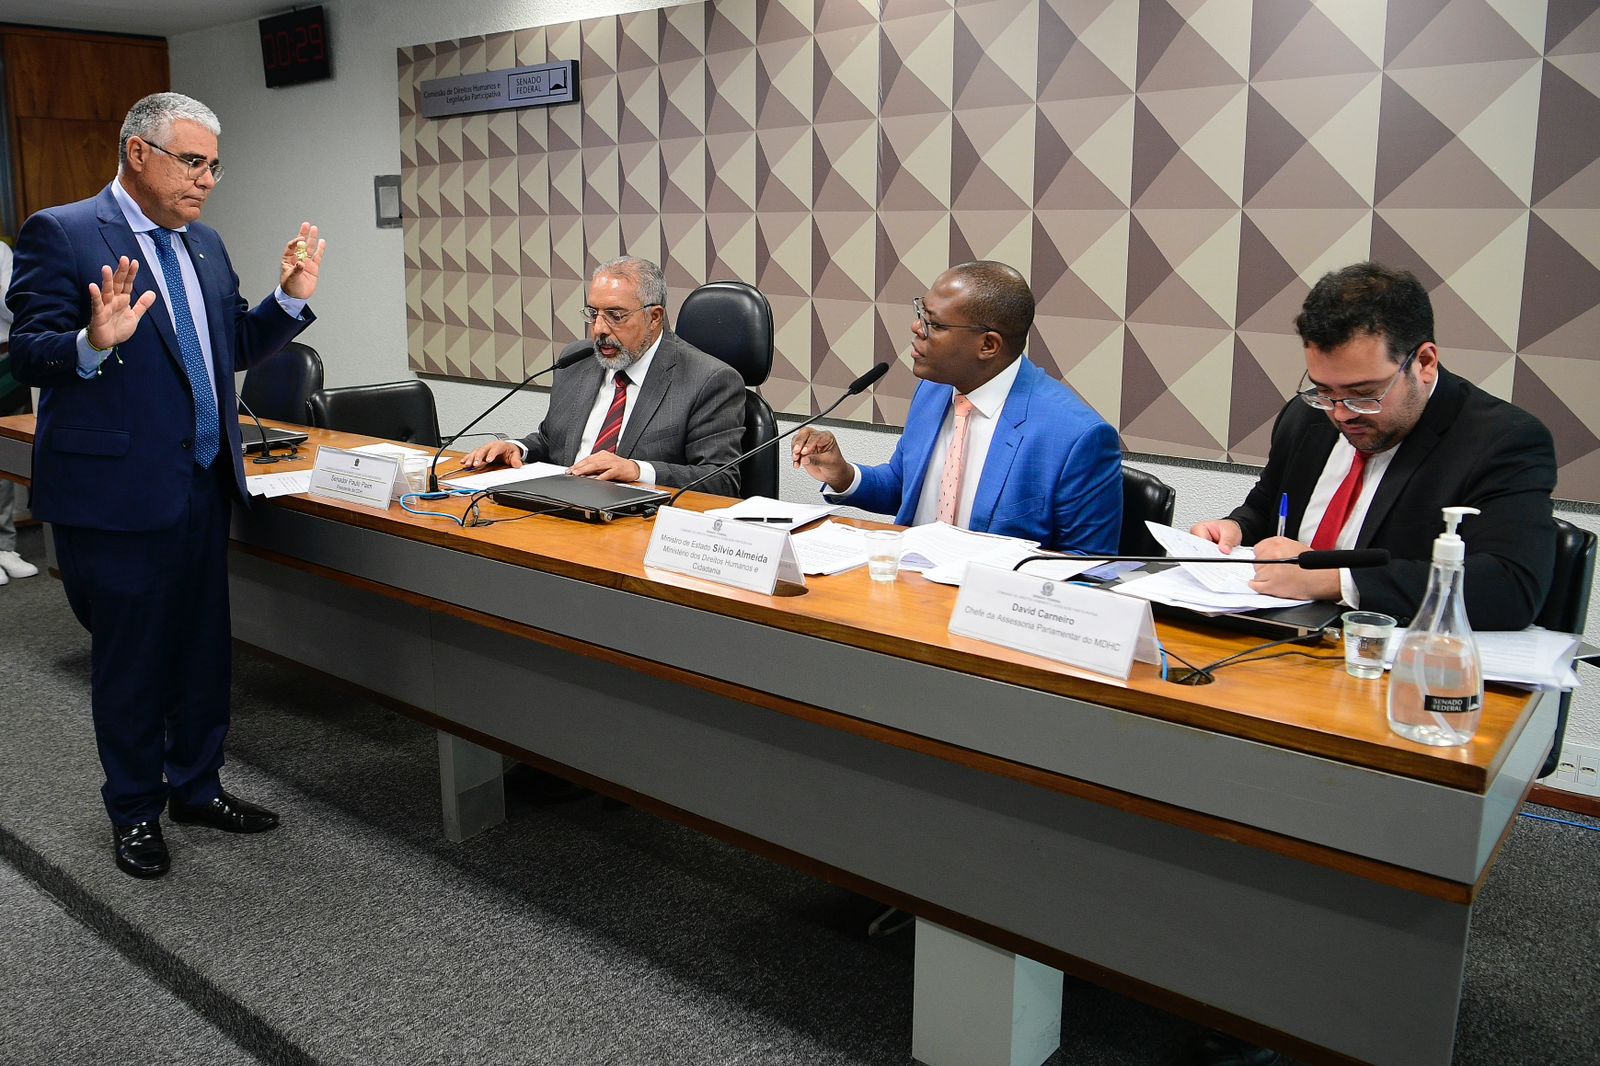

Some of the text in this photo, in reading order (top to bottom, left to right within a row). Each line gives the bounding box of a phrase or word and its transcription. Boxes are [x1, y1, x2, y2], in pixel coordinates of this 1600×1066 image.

[516, 76, 541, 86] SENADO
[447, 87, 452, 95] de
[454, 86, 472, 95] Direitos
[473, 84, 496, 92] Humanos
[516, 86, 541, 95] FEDERAL
[331, 474, 348, 484] Senador
[349, 478, 360, 487] Paulo
[661, 534, 682, 545] Ministro
[683, 538, 690, 546] de
[691, 540, 711, 551] Estado
[712, 544, 734, 556] Silvio
[735, 549, 768, 564] Almeida
[663, 545, 689, 557] Ministério
[690, 551, 701, 560] dos
[702, 554, 724, 565] Direitos
[724, 559, 753, 573] Humanos
[692, 563, 721, 575] Cidadania
[1011, 602, 1036, 616] David
[1037, 609, 1075, 626] Carneiro
[964, 604, 1121, 652] Chefe da Assessoria Parlamentar do MDHC
